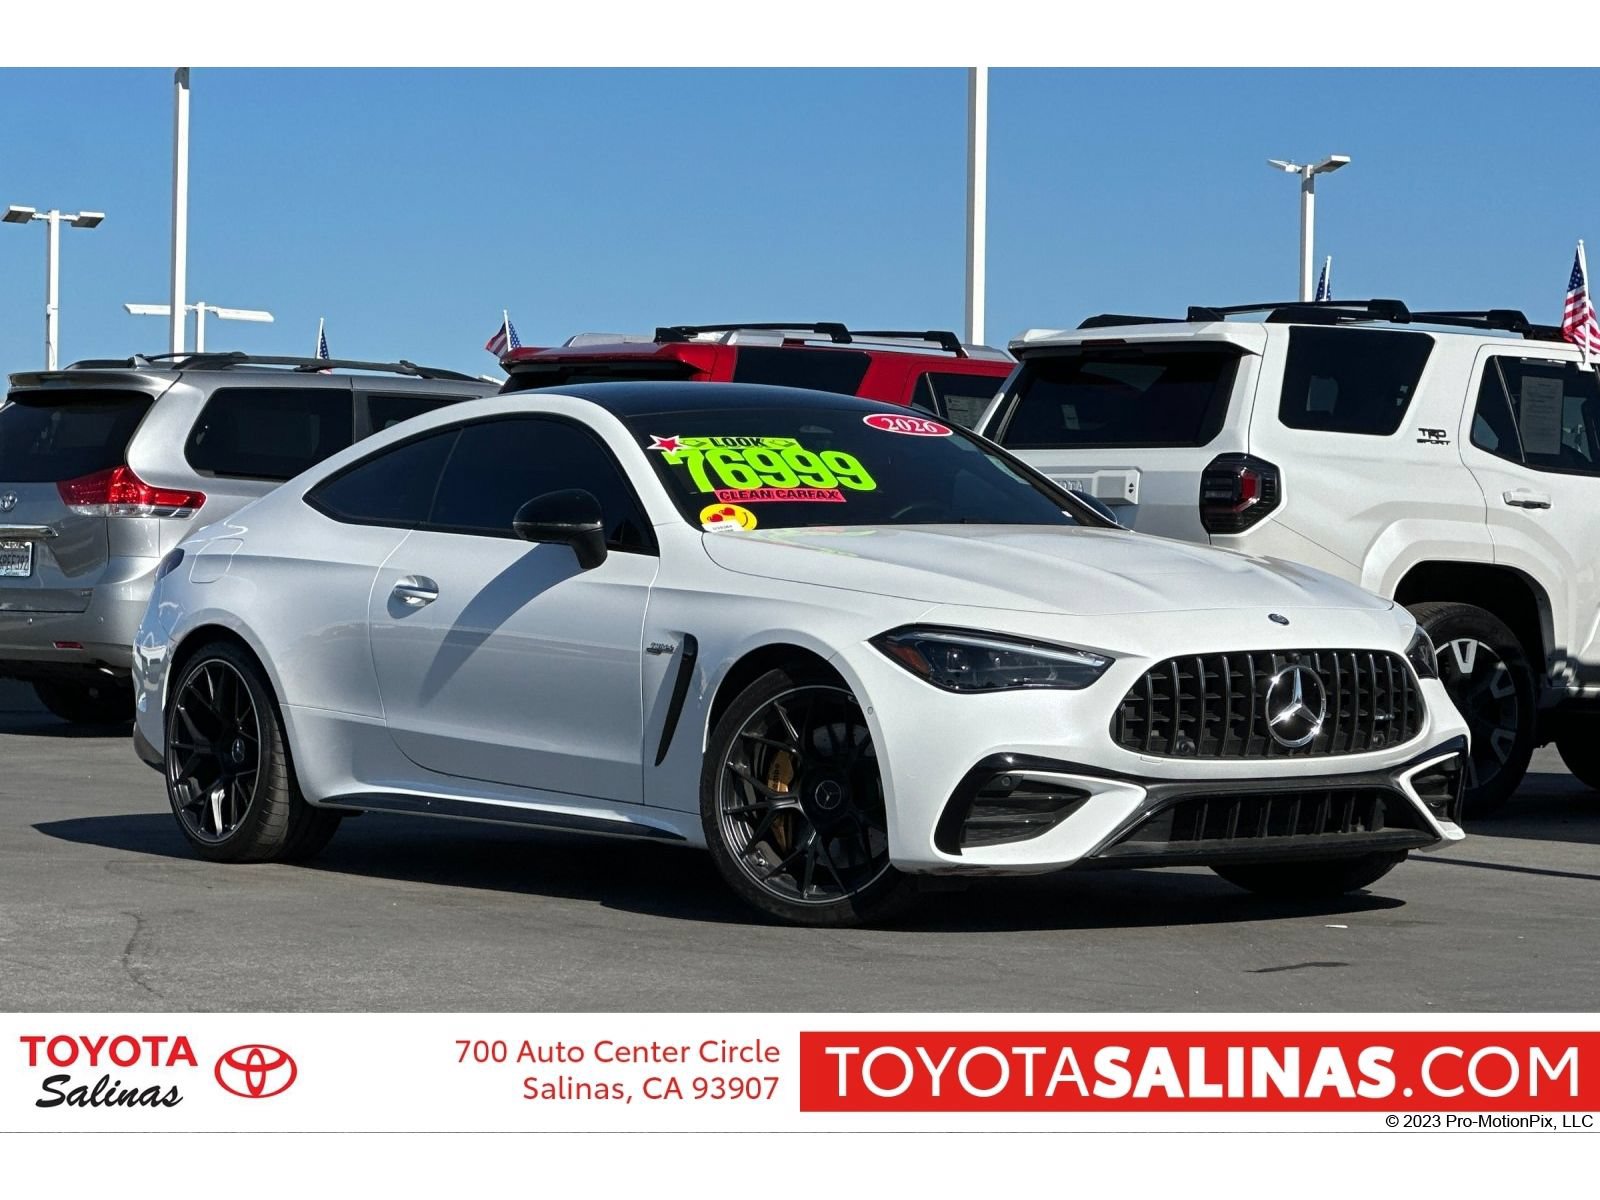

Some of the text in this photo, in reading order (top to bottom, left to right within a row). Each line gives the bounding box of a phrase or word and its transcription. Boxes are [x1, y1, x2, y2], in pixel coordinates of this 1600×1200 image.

[881, 417, 938, 433] 2026
[1418, 427, 1447, 440] TRD
[708, 437, 767, 448] LOOK
[661, 448, 877, 493] 76999
[719, 488, 840, 501] CLEAN CARFAX
